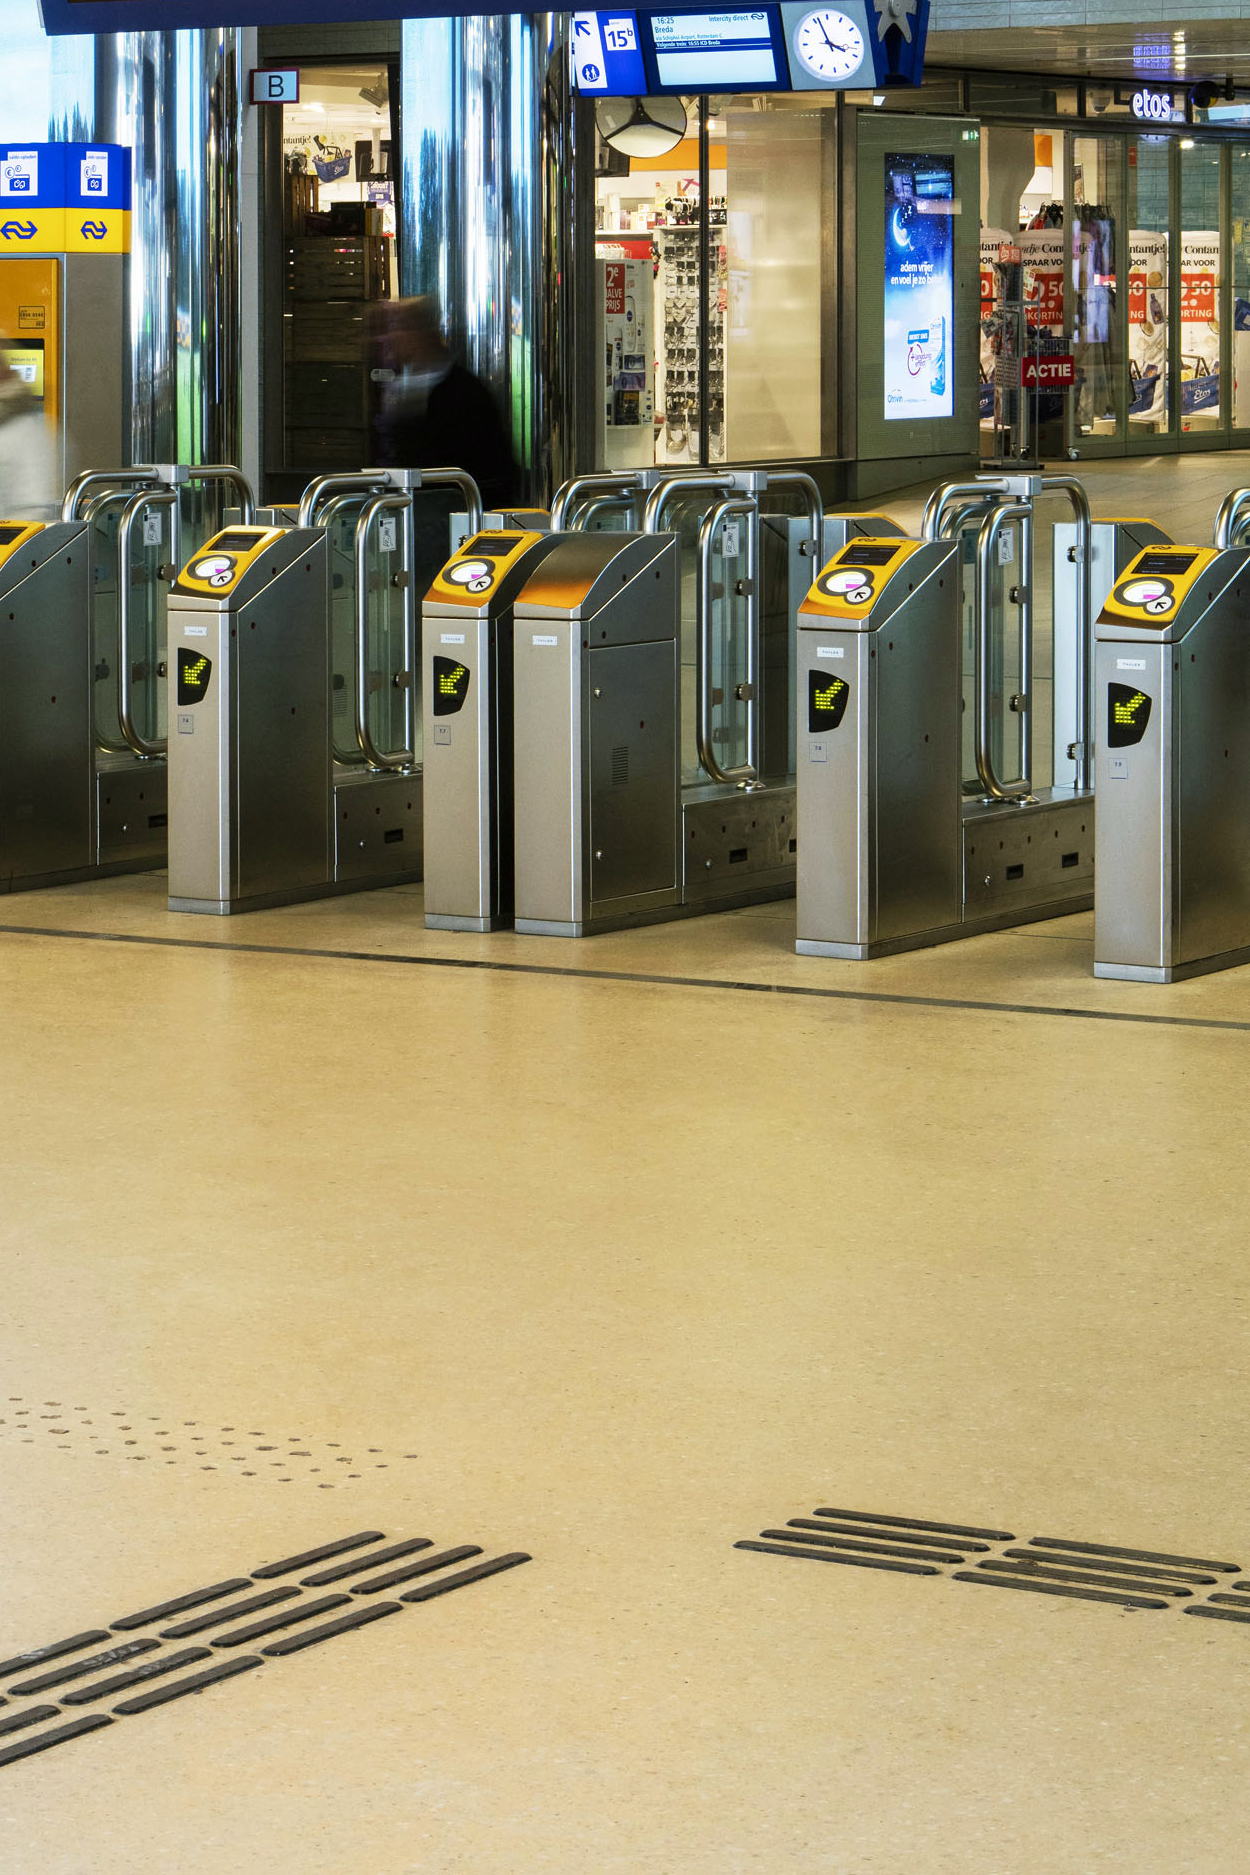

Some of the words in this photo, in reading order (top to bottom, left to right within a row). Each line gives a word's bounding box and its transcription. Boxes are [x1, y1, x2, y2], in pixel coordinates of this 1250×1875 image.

[268, 75, 284, 98] B
[1133, 88, 1171, 118] etos
[1184, 245, 1219, 254] Contan
[900, 261, 918, 272] adem
[918, 261, 934, 275] vrijer
[1023, 259, 1049, 267] SPAAR
[1193, 259, 1216, 267] VOOR
[891, 276, 899, 284] en
[899, 275, 912, 285] voel
[912, 275, 918, 288] je
[918, 276, 926, 285] zo
[1026, 364, 1072, 378] ACTIE
[1193, 389, 1211, 401] Etos
